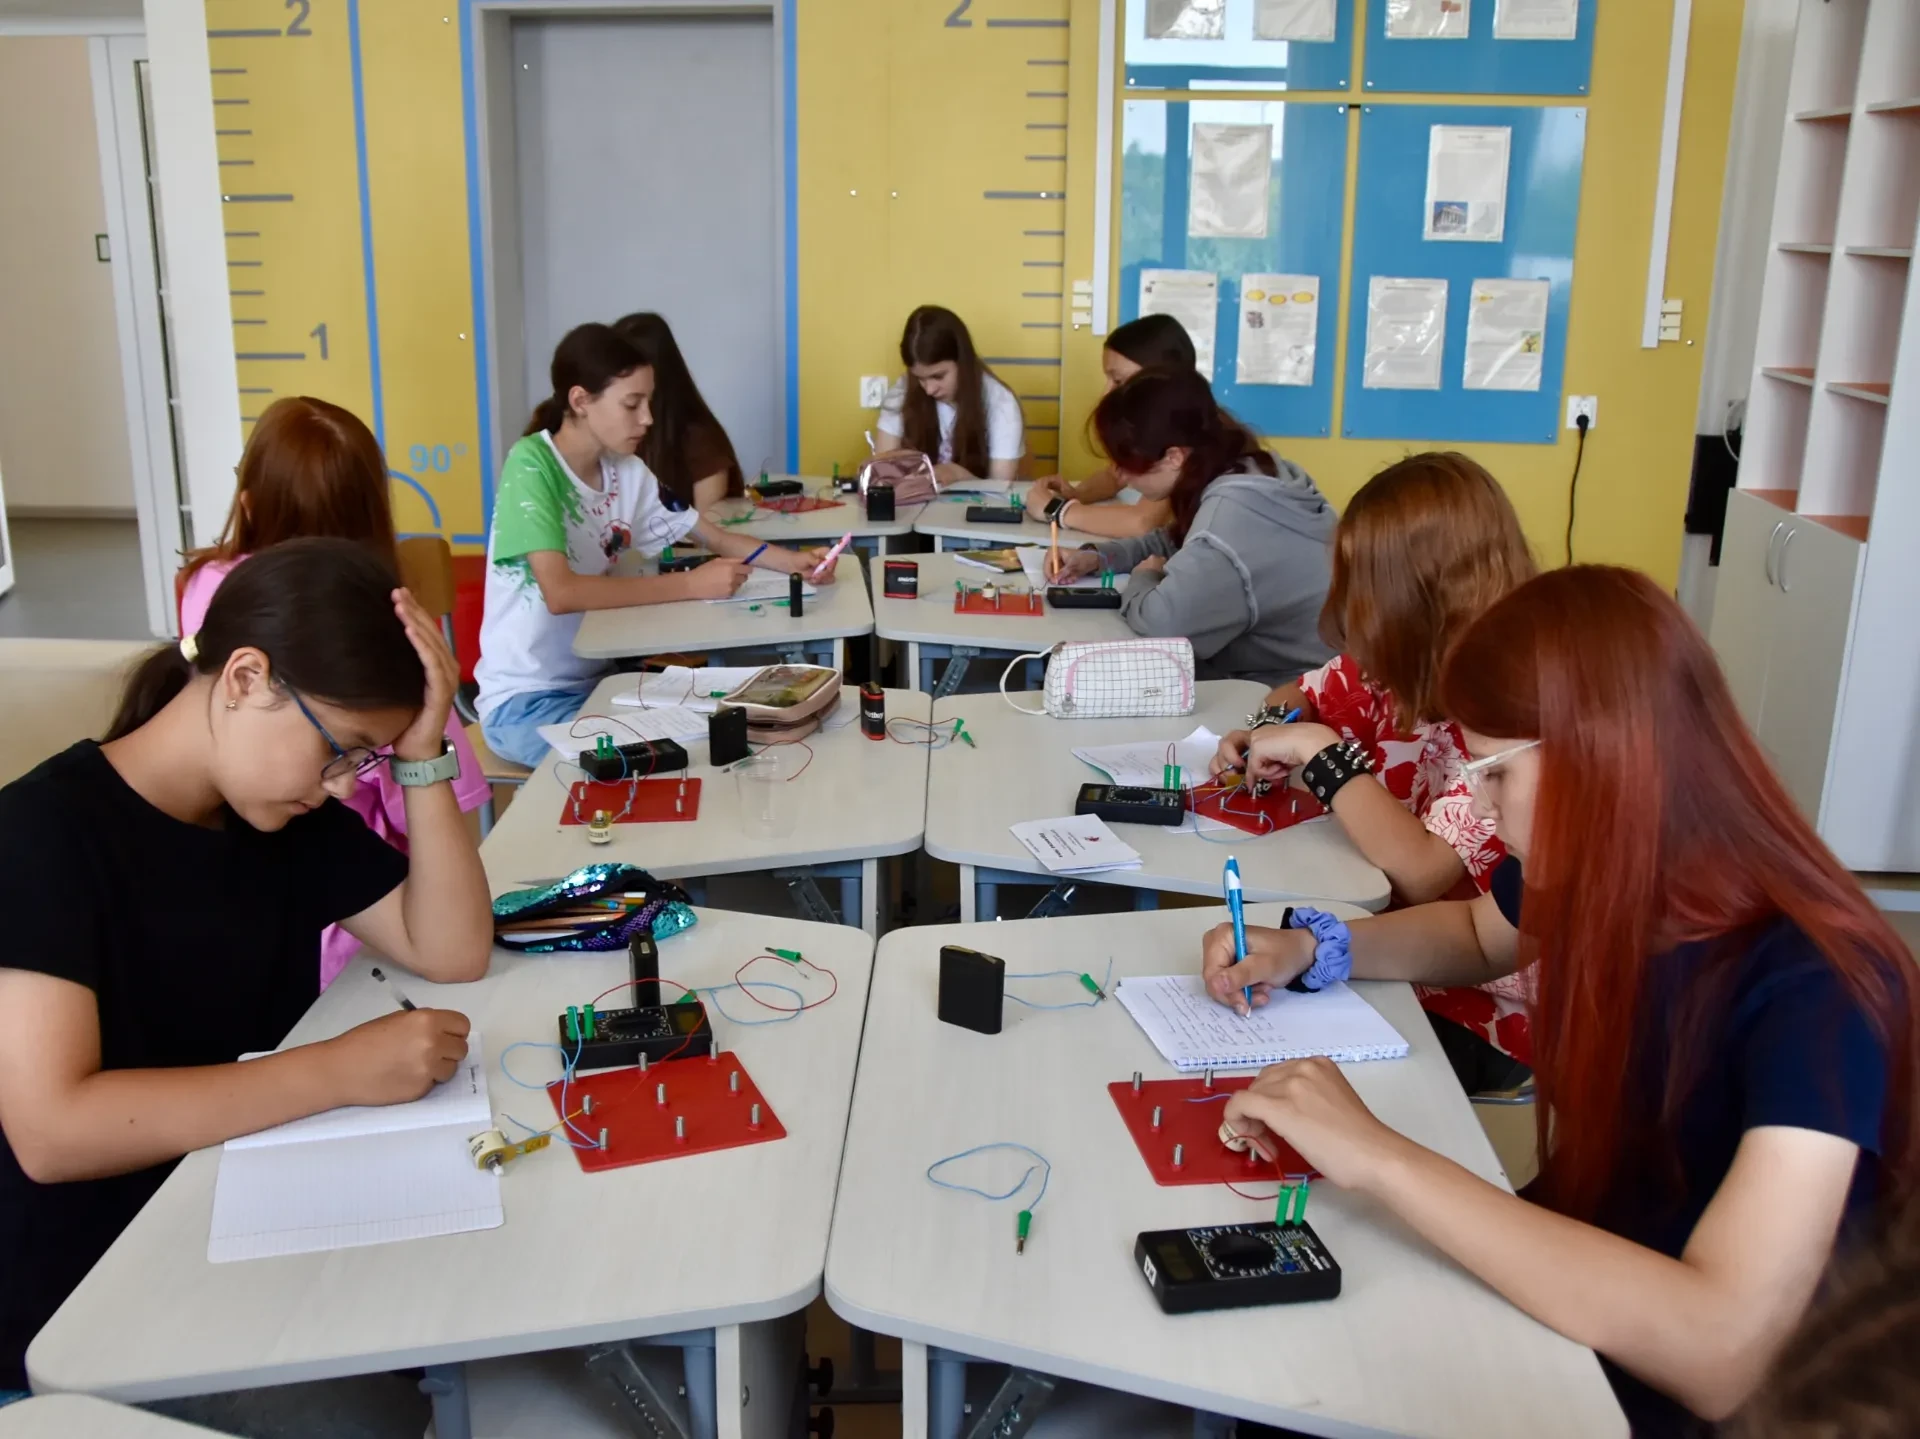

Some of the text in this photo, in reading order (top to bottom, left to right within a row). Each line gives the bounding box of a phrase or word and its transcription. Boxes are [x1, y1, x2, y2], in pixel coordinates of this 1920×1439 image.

[285, 0, 312, 36] 2
[944, 0, 972, 28] 2
[309, 322, 329, 360] 1
